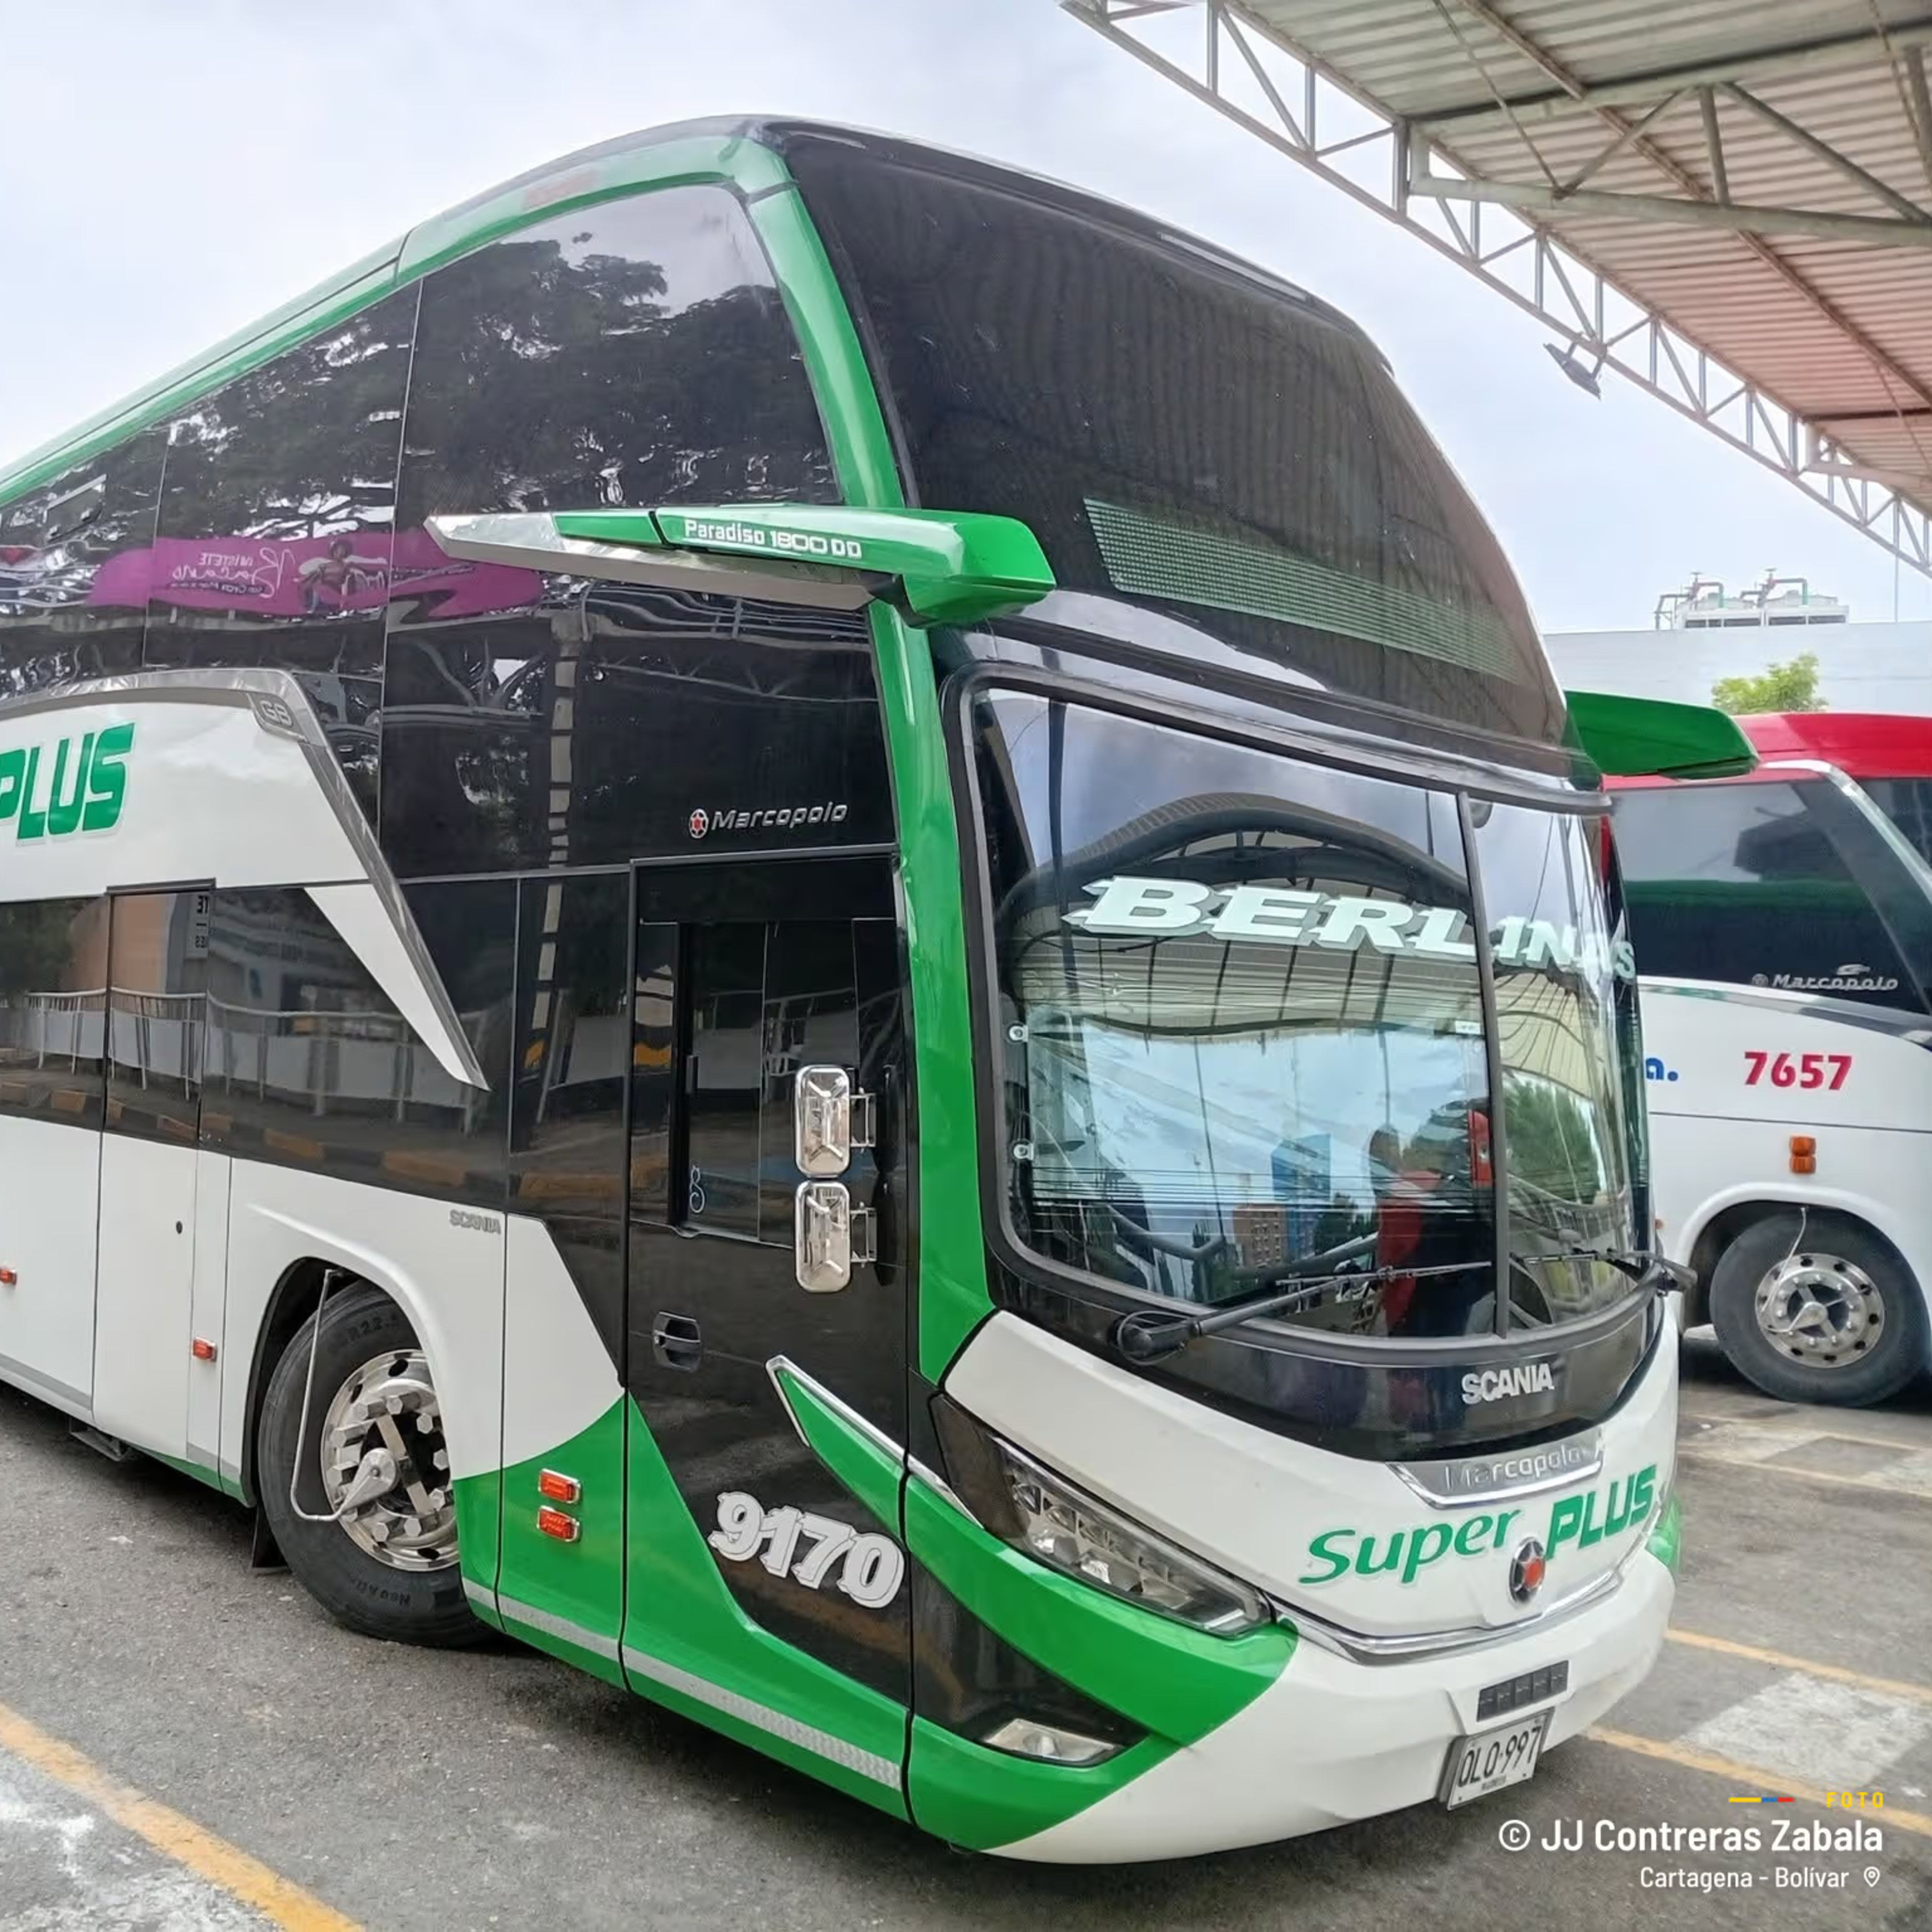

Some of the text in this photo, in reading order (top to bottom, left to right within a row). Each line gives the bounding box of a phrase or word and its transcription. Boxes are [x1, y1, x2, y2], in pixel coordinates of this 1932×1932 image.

[684, 519, 862, 559] Paradiso 1800 DD
[0, 722, 135, 839] PLUS
[711, 801, 848, 830] Marcopolo
[1772, 974, 1899, 990] Marcopolo
[1743, 1052, 1853, 1091] 7657
[449, 1209, 501, 1235] SCANIA
[1462, 1363, 1555, 1405] SCANIA
[1444, 1444, 1582, 1491] Marcopolo
[1298, 1464, 1658, 1584] Super PLUS
[707, 1490, 905, 1608] 9170
